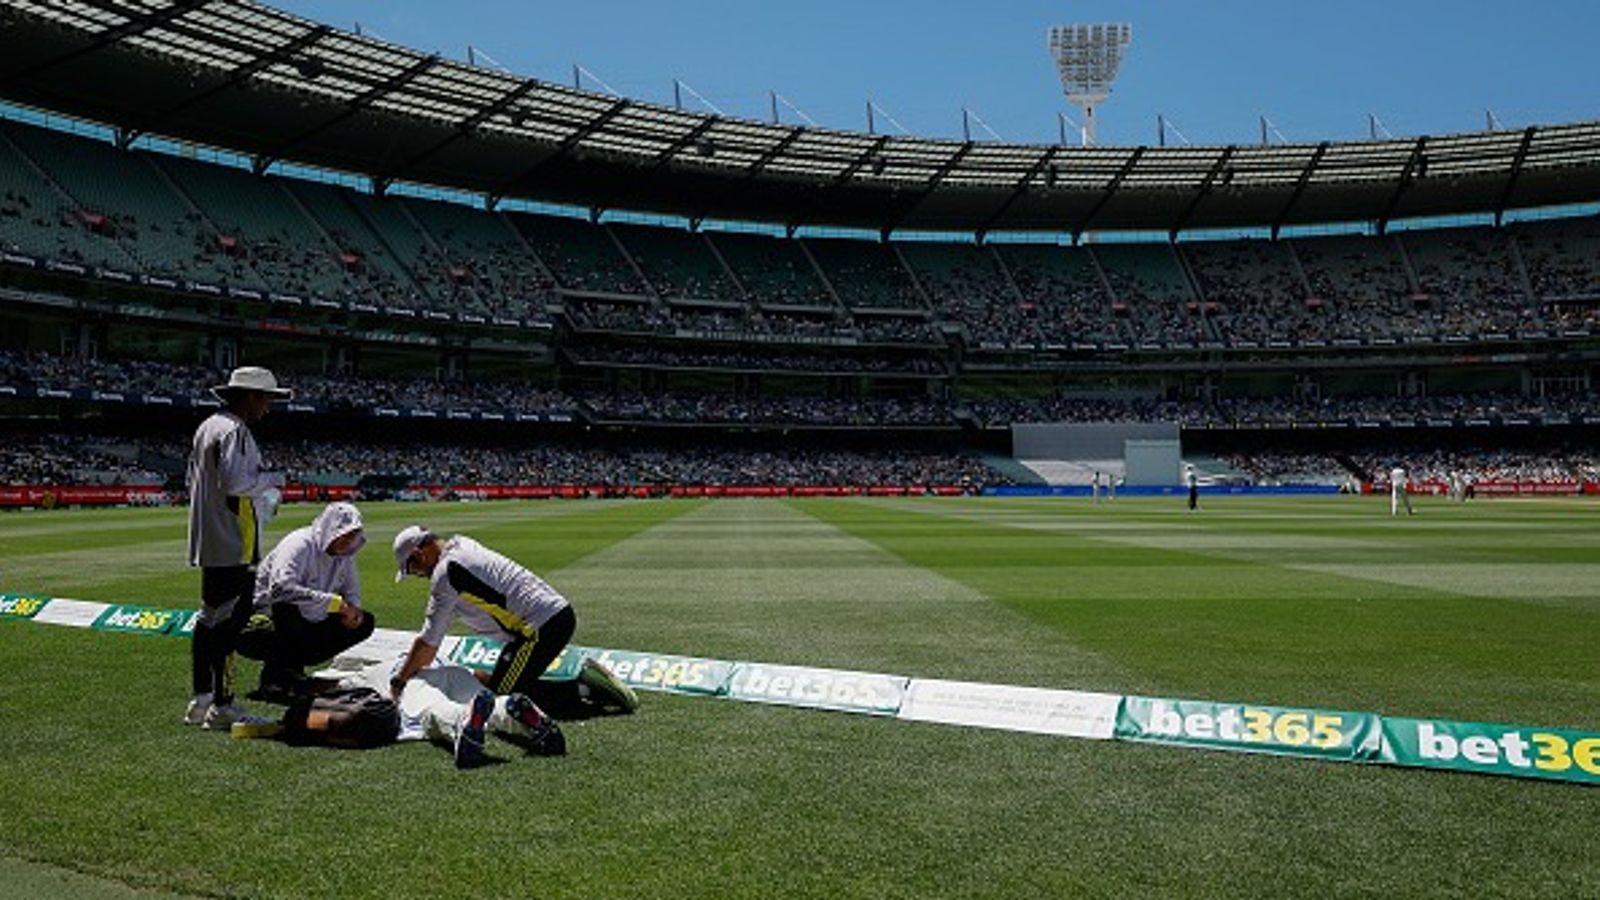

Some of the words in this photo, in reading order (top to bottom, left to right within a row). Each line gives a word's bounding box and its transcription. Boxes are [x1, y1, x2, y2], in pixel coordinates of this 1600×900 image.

[104, 607, 172, 629] bet365
[742, 667, 877, 708] bet365
[1149, 701, 1344, 749] bet365
